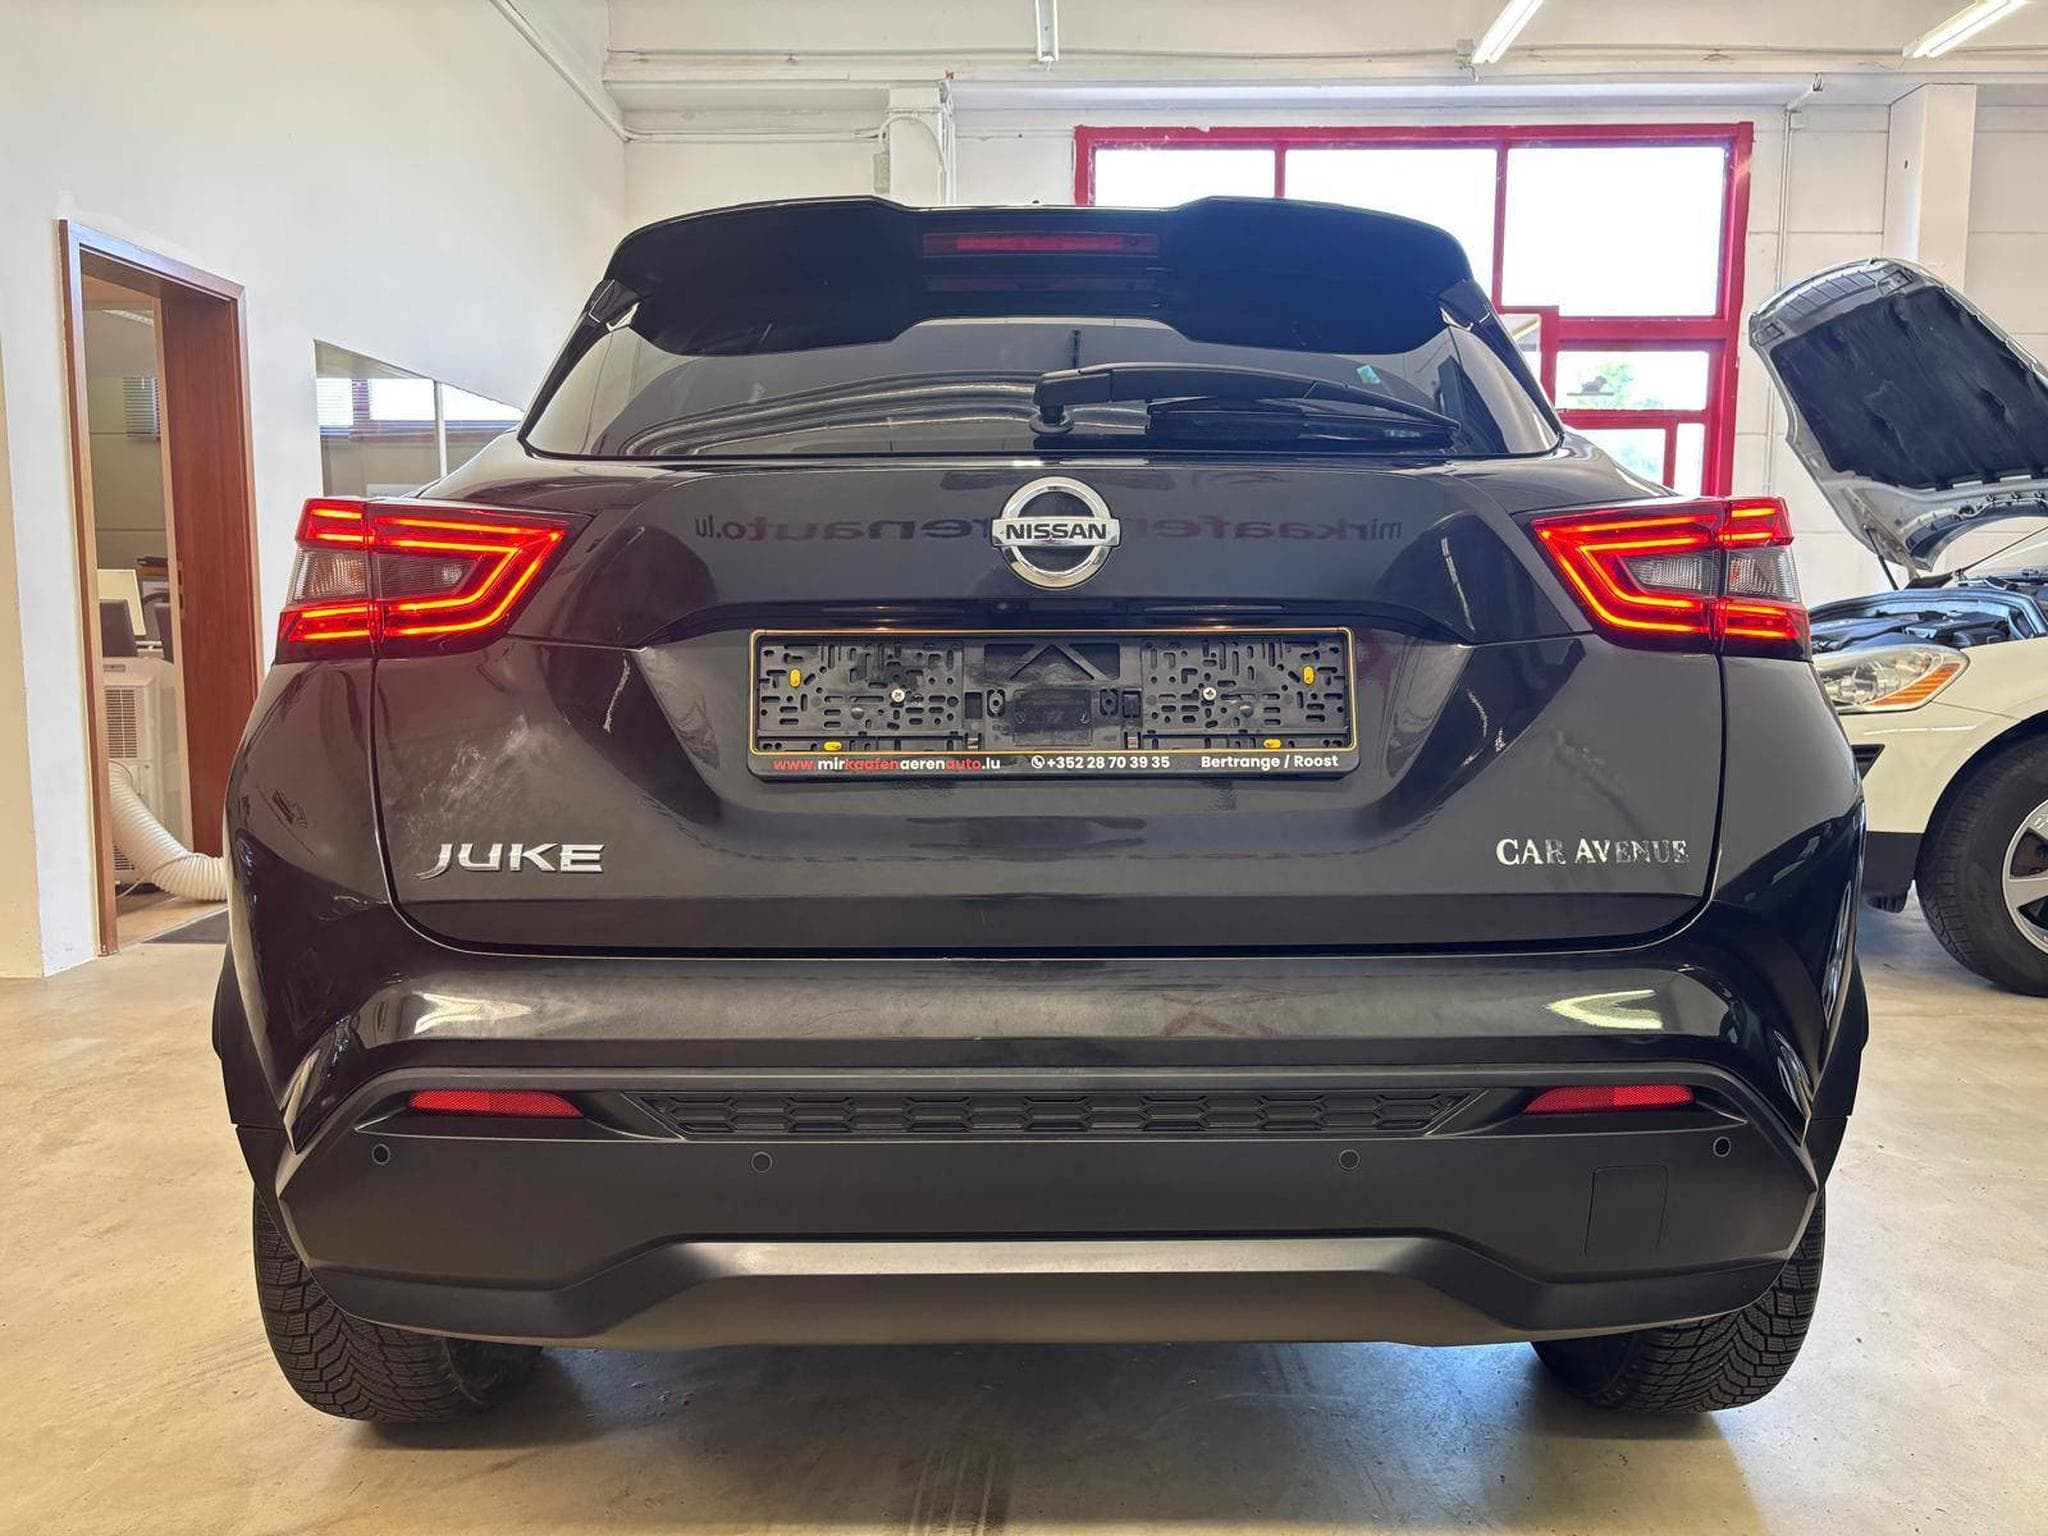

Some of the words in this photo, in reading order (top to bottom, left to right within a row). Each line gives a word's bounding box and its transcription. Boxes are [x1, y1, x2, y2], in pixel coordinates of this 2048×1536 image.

[1006, 523, 1107, 539] NISSAN
[773, 756, 1001, 772] www.mirkaafenaerenauto.lu
[1047, 755, 1084, 769] +352
[1086, 755, 1105, 769] 28
[1108, 755, 1127, 769] 70
[1129, 755, 1148, 769] 39
[1151, 755, 1171, 769] 35
[1201, 755, 1281, 771] Bertrange
[1294, 755, 1340, 768] Roost
[1495, 838, 1566, 866] CAR
[1574, 838, 1690, 866] AVENUE
[414, 843, 605, 881] JUKE
